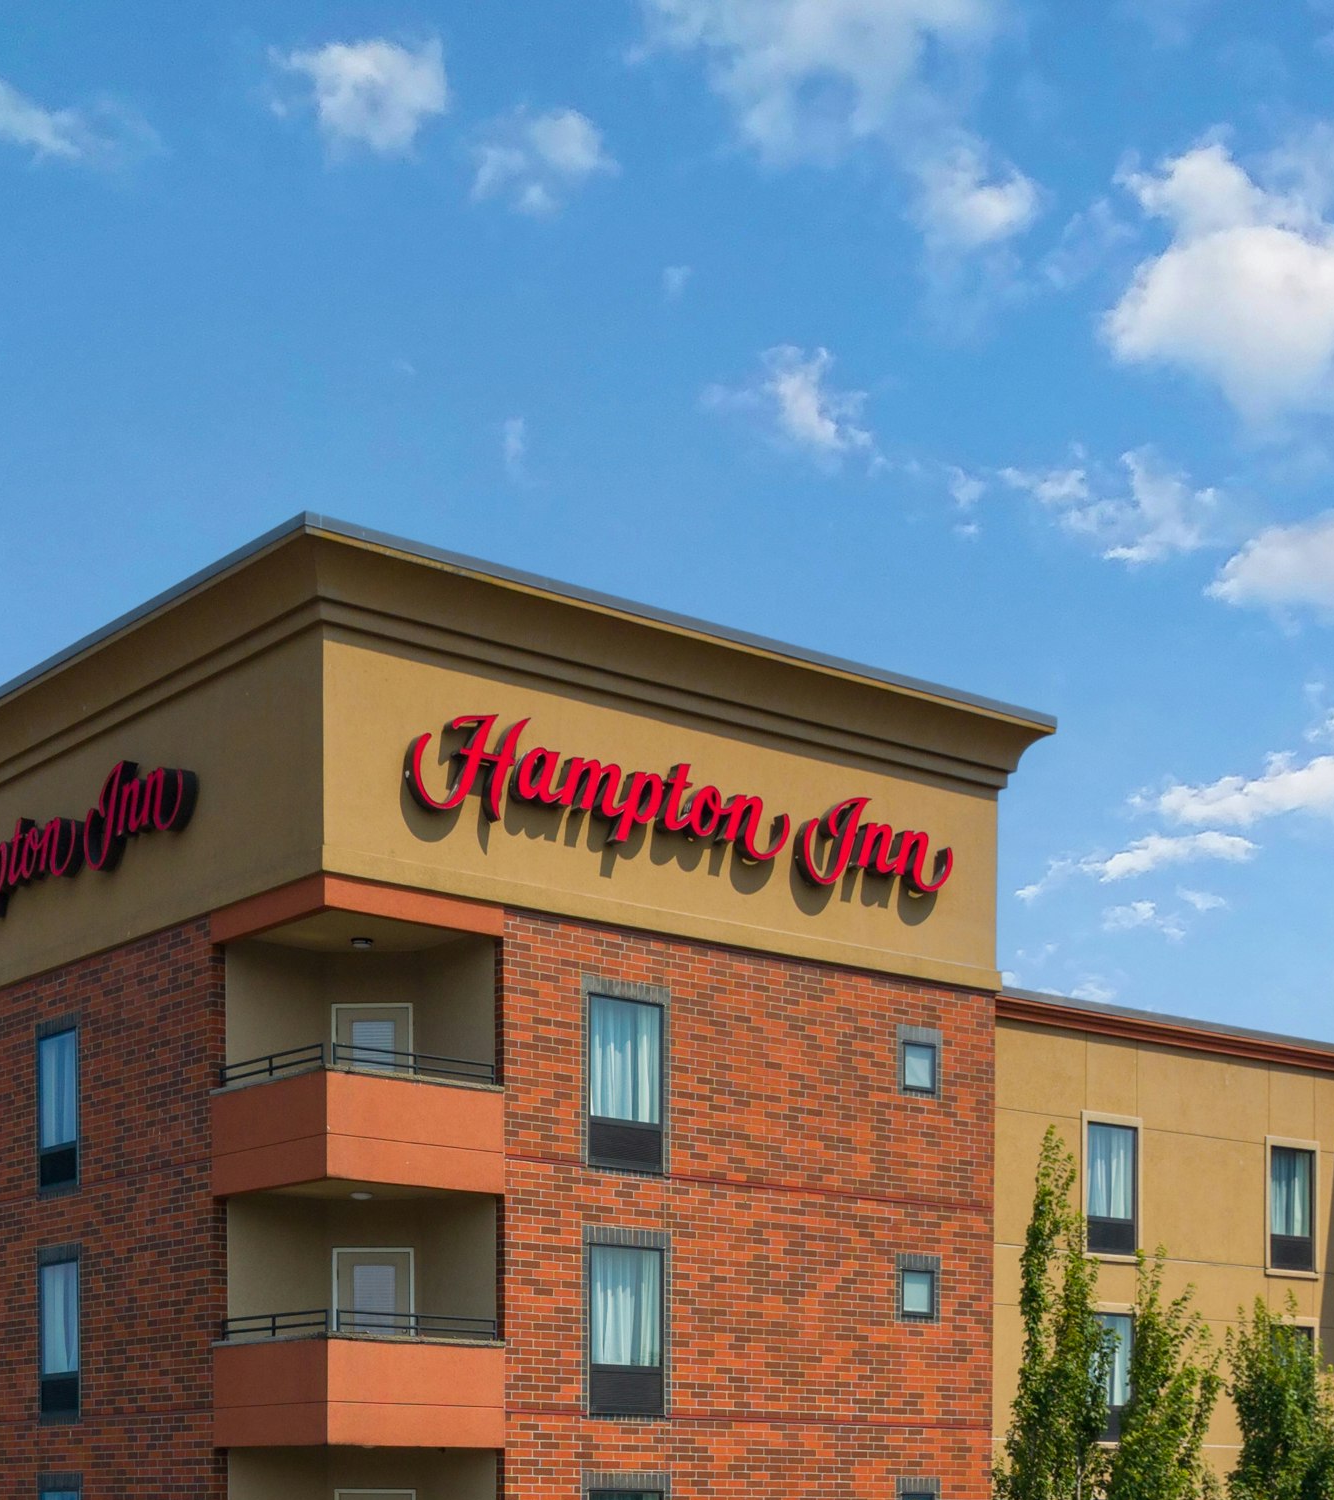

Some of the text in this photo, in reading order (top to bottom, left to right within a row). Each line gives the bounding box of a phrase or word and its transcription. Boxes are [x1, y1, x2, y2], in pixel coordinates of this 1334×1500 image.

[83, 760, 198, 871] Inn
[405, 713, 954, 894] Hampton Inn
